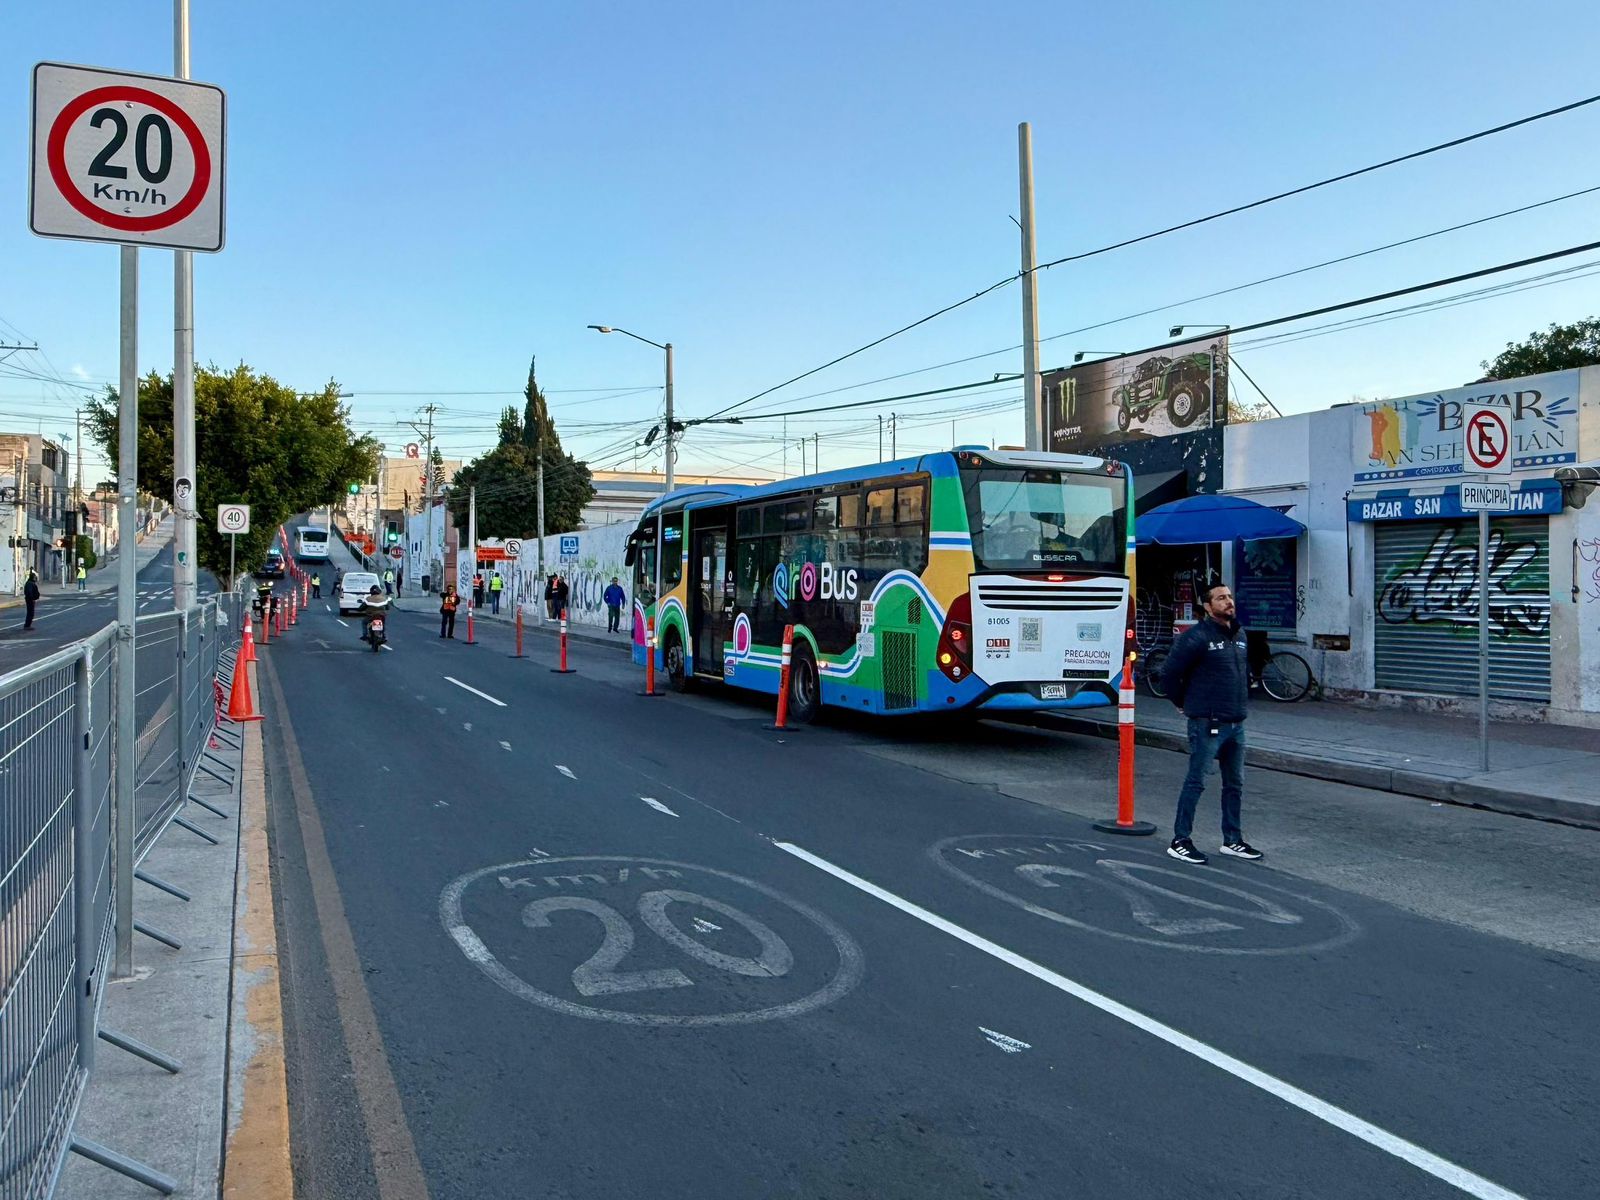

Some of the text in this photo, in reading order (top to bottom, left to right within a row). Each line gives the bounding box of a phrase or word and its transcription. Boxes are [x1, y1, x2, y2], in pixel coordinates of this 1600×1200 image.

[88, 108, 173, 184] 20
[93, 183, 167, 205] Km/h
[1464, 487, 1508, 504] PRINCIPIA
[227, 511, 240, 522] 40
[1362, 502, 1402, 519] BAZAR
[1414, 498, 1441, 515] SAN
[1015, 859, 1302, 936] 20
[521, 889, 794, 997] 20
